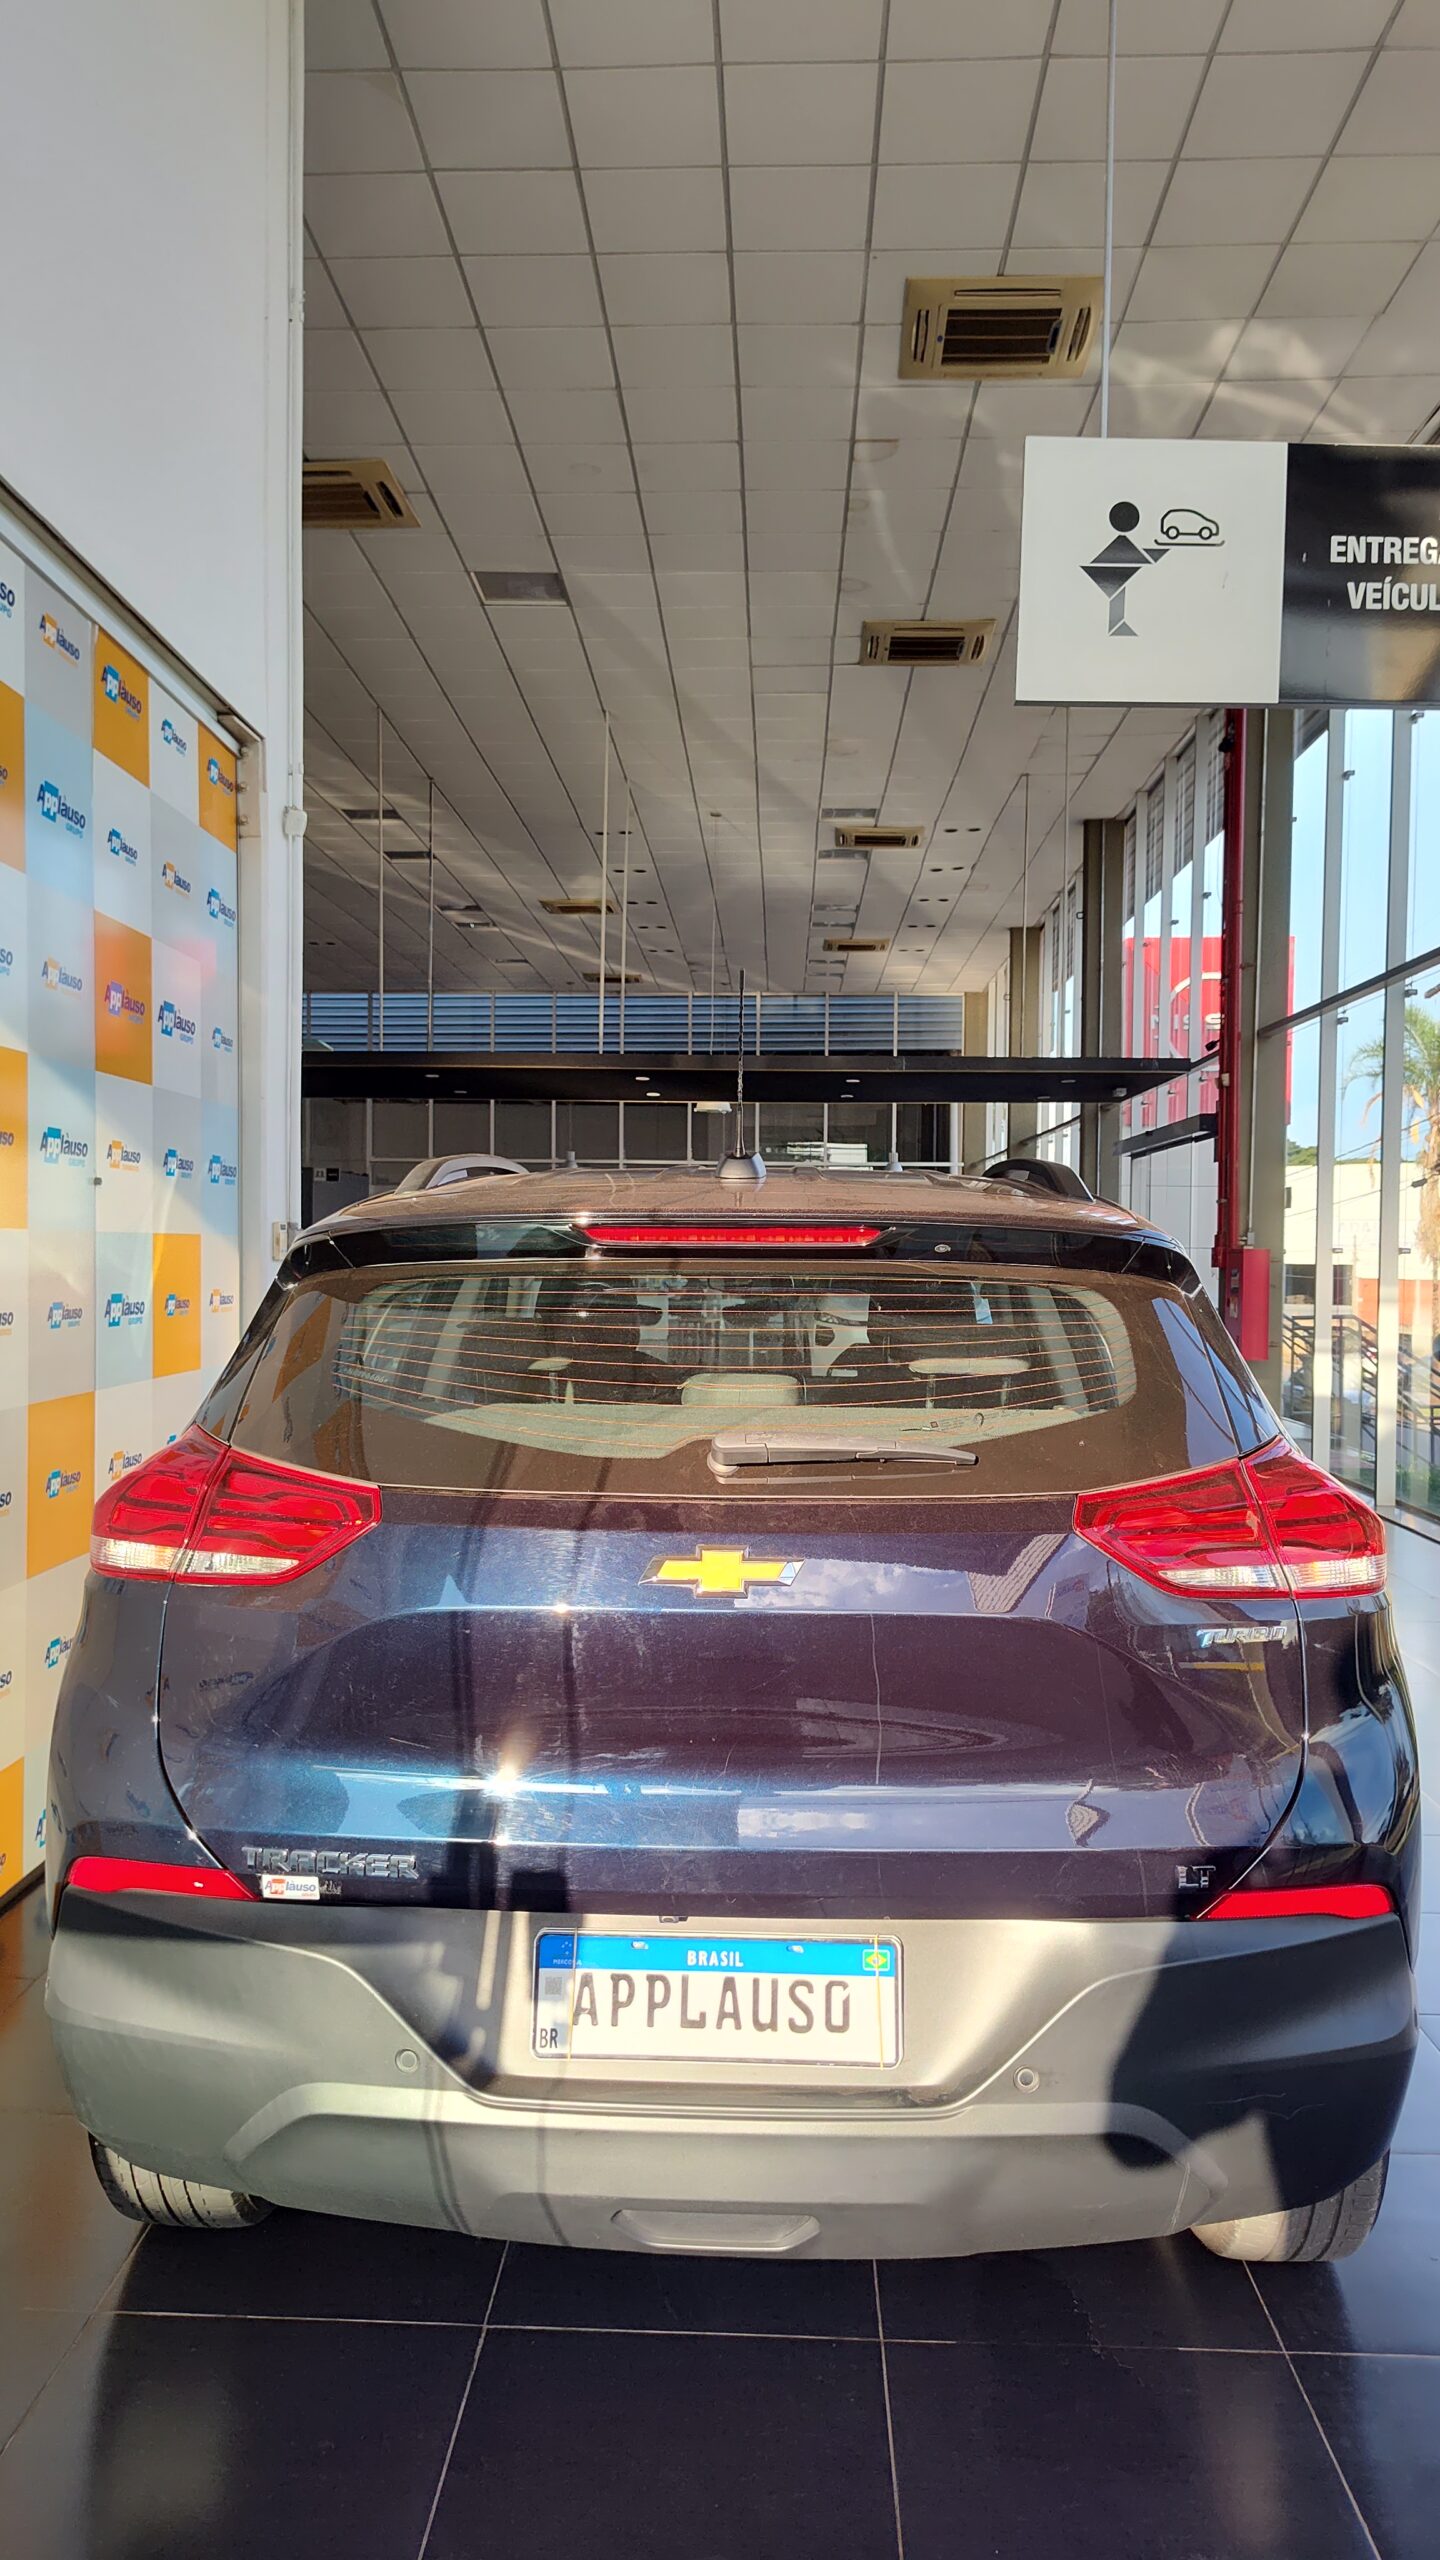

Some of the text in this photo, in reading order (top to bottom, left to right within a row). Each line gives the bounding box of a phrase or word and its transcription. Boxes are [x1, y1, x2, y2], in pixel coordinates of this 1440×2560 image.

[1330, 534, 1440, 565] ENTREG
[241, 1846, 419, 1879] TRACKER
[1176, 1865, 1216, 1888] LT
[687, 1950, 744, 1967] BRASIL
[573, 1973, 850, 2034] APPLAUSO
[539, 2028, 558, 2048] BR
